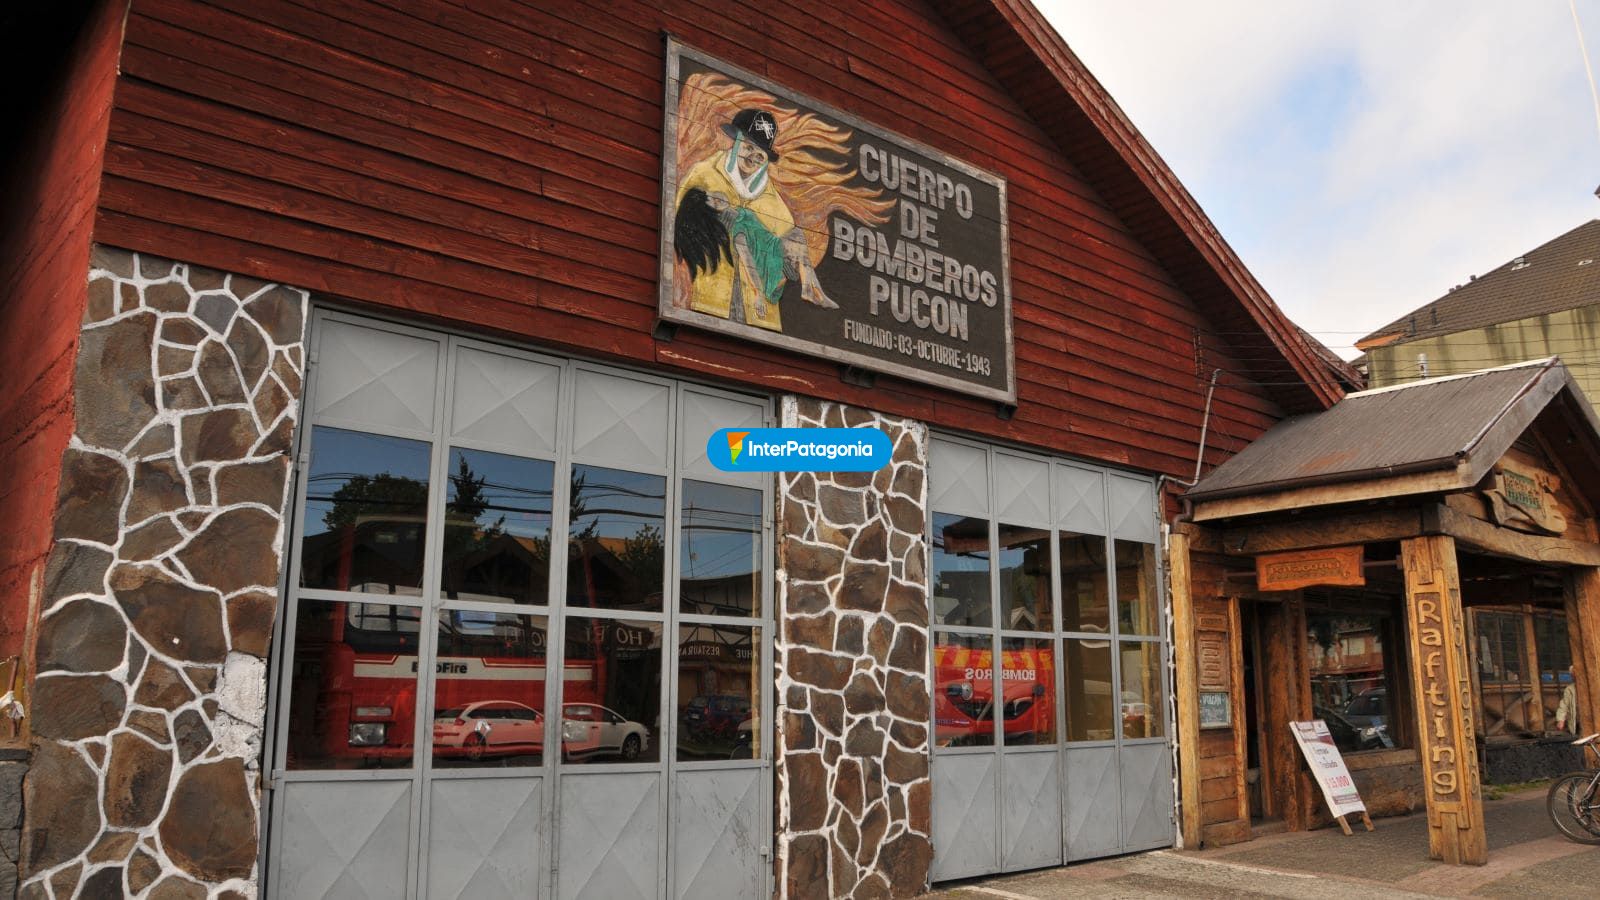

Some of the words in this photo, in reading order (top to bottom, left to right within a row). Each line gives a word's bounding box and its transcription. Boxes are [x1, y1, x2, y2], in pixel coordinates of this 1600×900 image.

[859, 143, 973, 220] CUERPO
[900, 199, 939, 248] DE
[833, 217, 998, 308] BOMBEROS
[870, 275, 969, 341] PUCON
[411, 661, 468, 674] EoFire
[1417, 599, 1457, 794] Rafting
